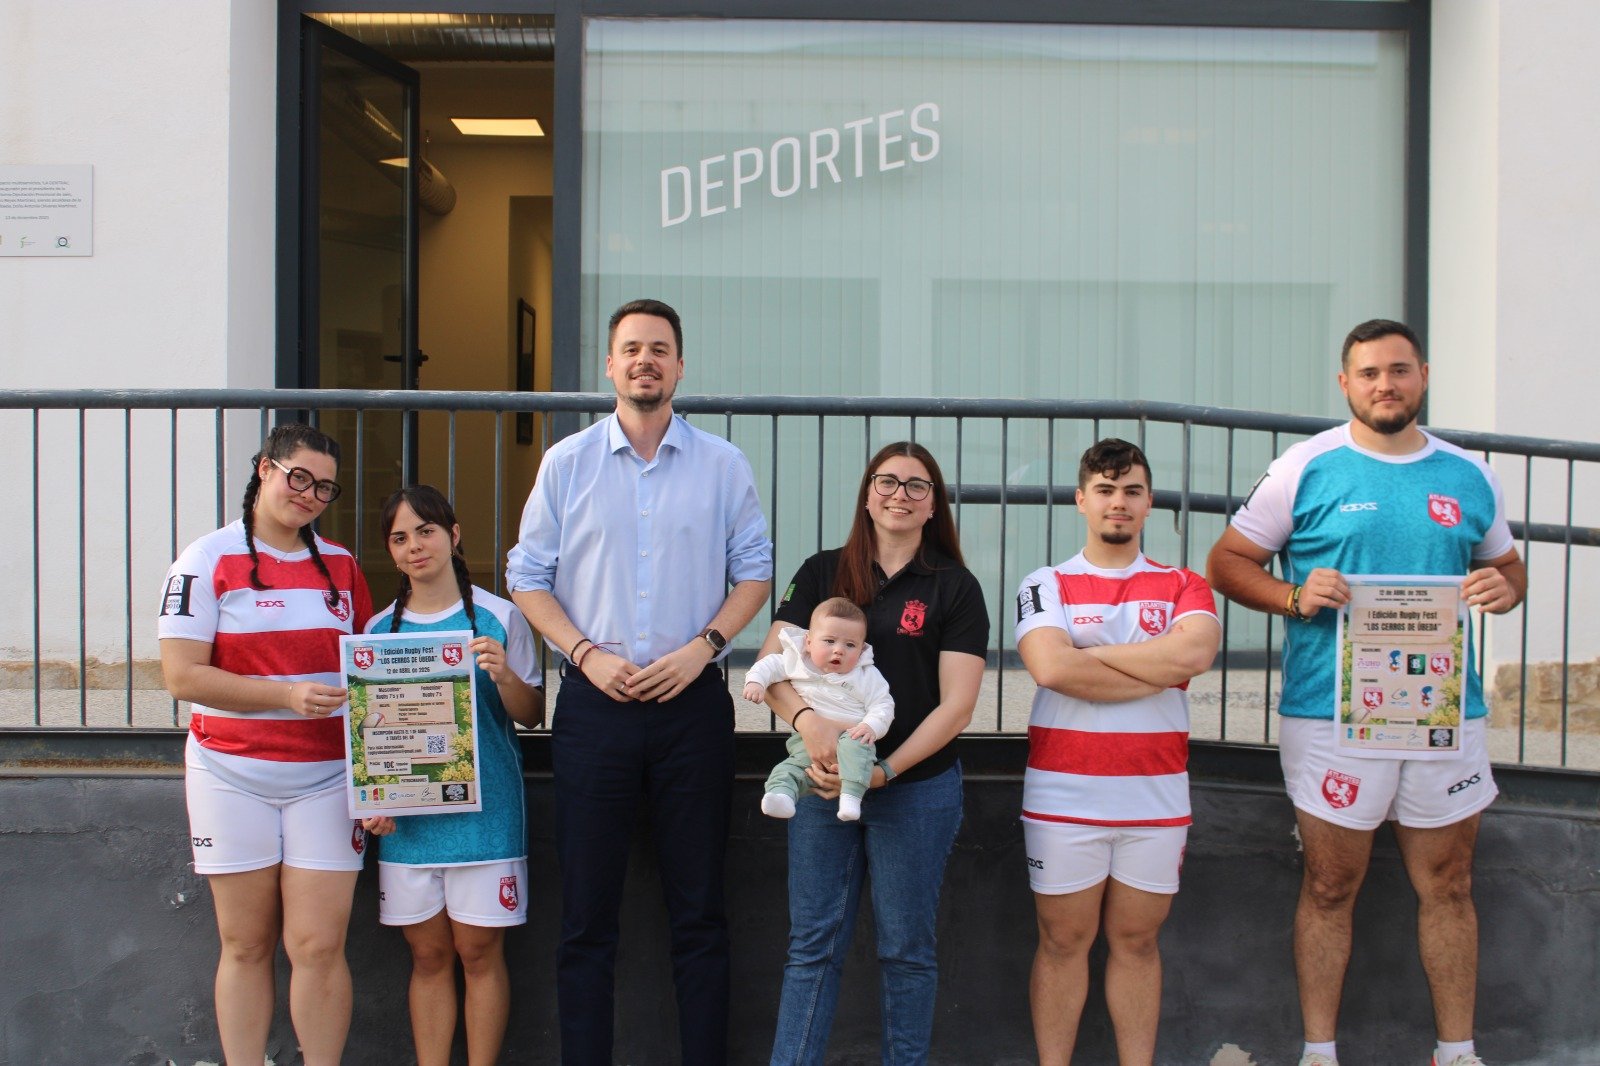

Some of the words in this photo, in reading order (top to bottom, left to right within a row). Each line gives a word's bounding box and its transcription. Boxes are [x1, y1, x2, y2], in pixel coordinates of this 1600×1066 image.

[661, 102, 940, 228] DEPORTES
[1399, 611, 1420, 620] Rugby
[1423, 611, 1438, 619] Fest
[1381, 623, 1405, 631] CERROS
[1407, 623, 1416, 631] DE
[384, 648, 404, 656] Edición
[404, 648, 421, 656] Rugby
